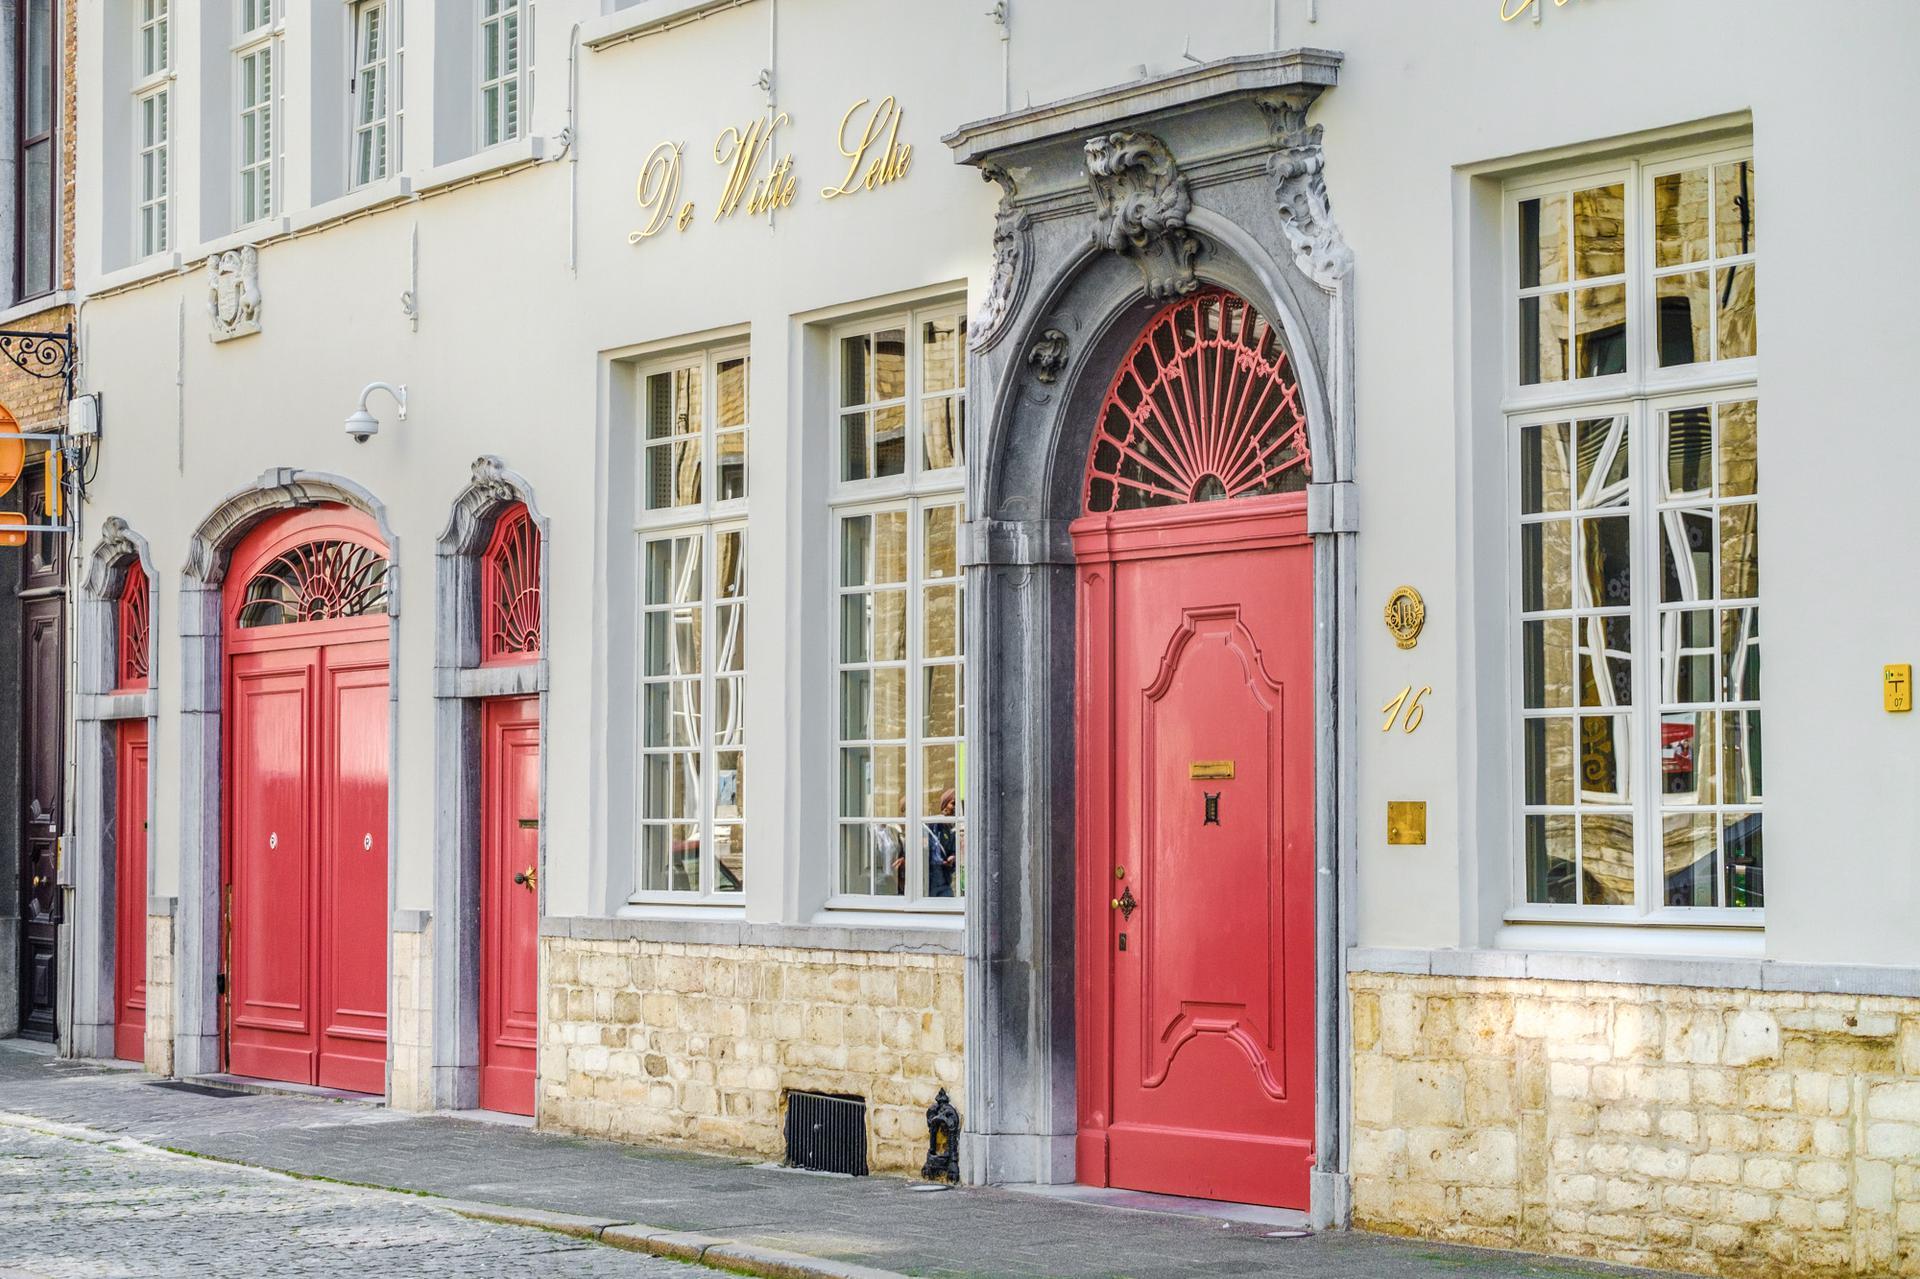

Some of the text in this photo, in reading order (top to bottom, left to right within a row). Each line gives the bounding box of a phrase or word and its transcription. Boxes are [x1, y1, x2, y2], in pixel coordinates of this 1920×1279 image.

[628, 95, 912, 244] De Witte Lelie
[1382, 685, 1432, 734] 16
